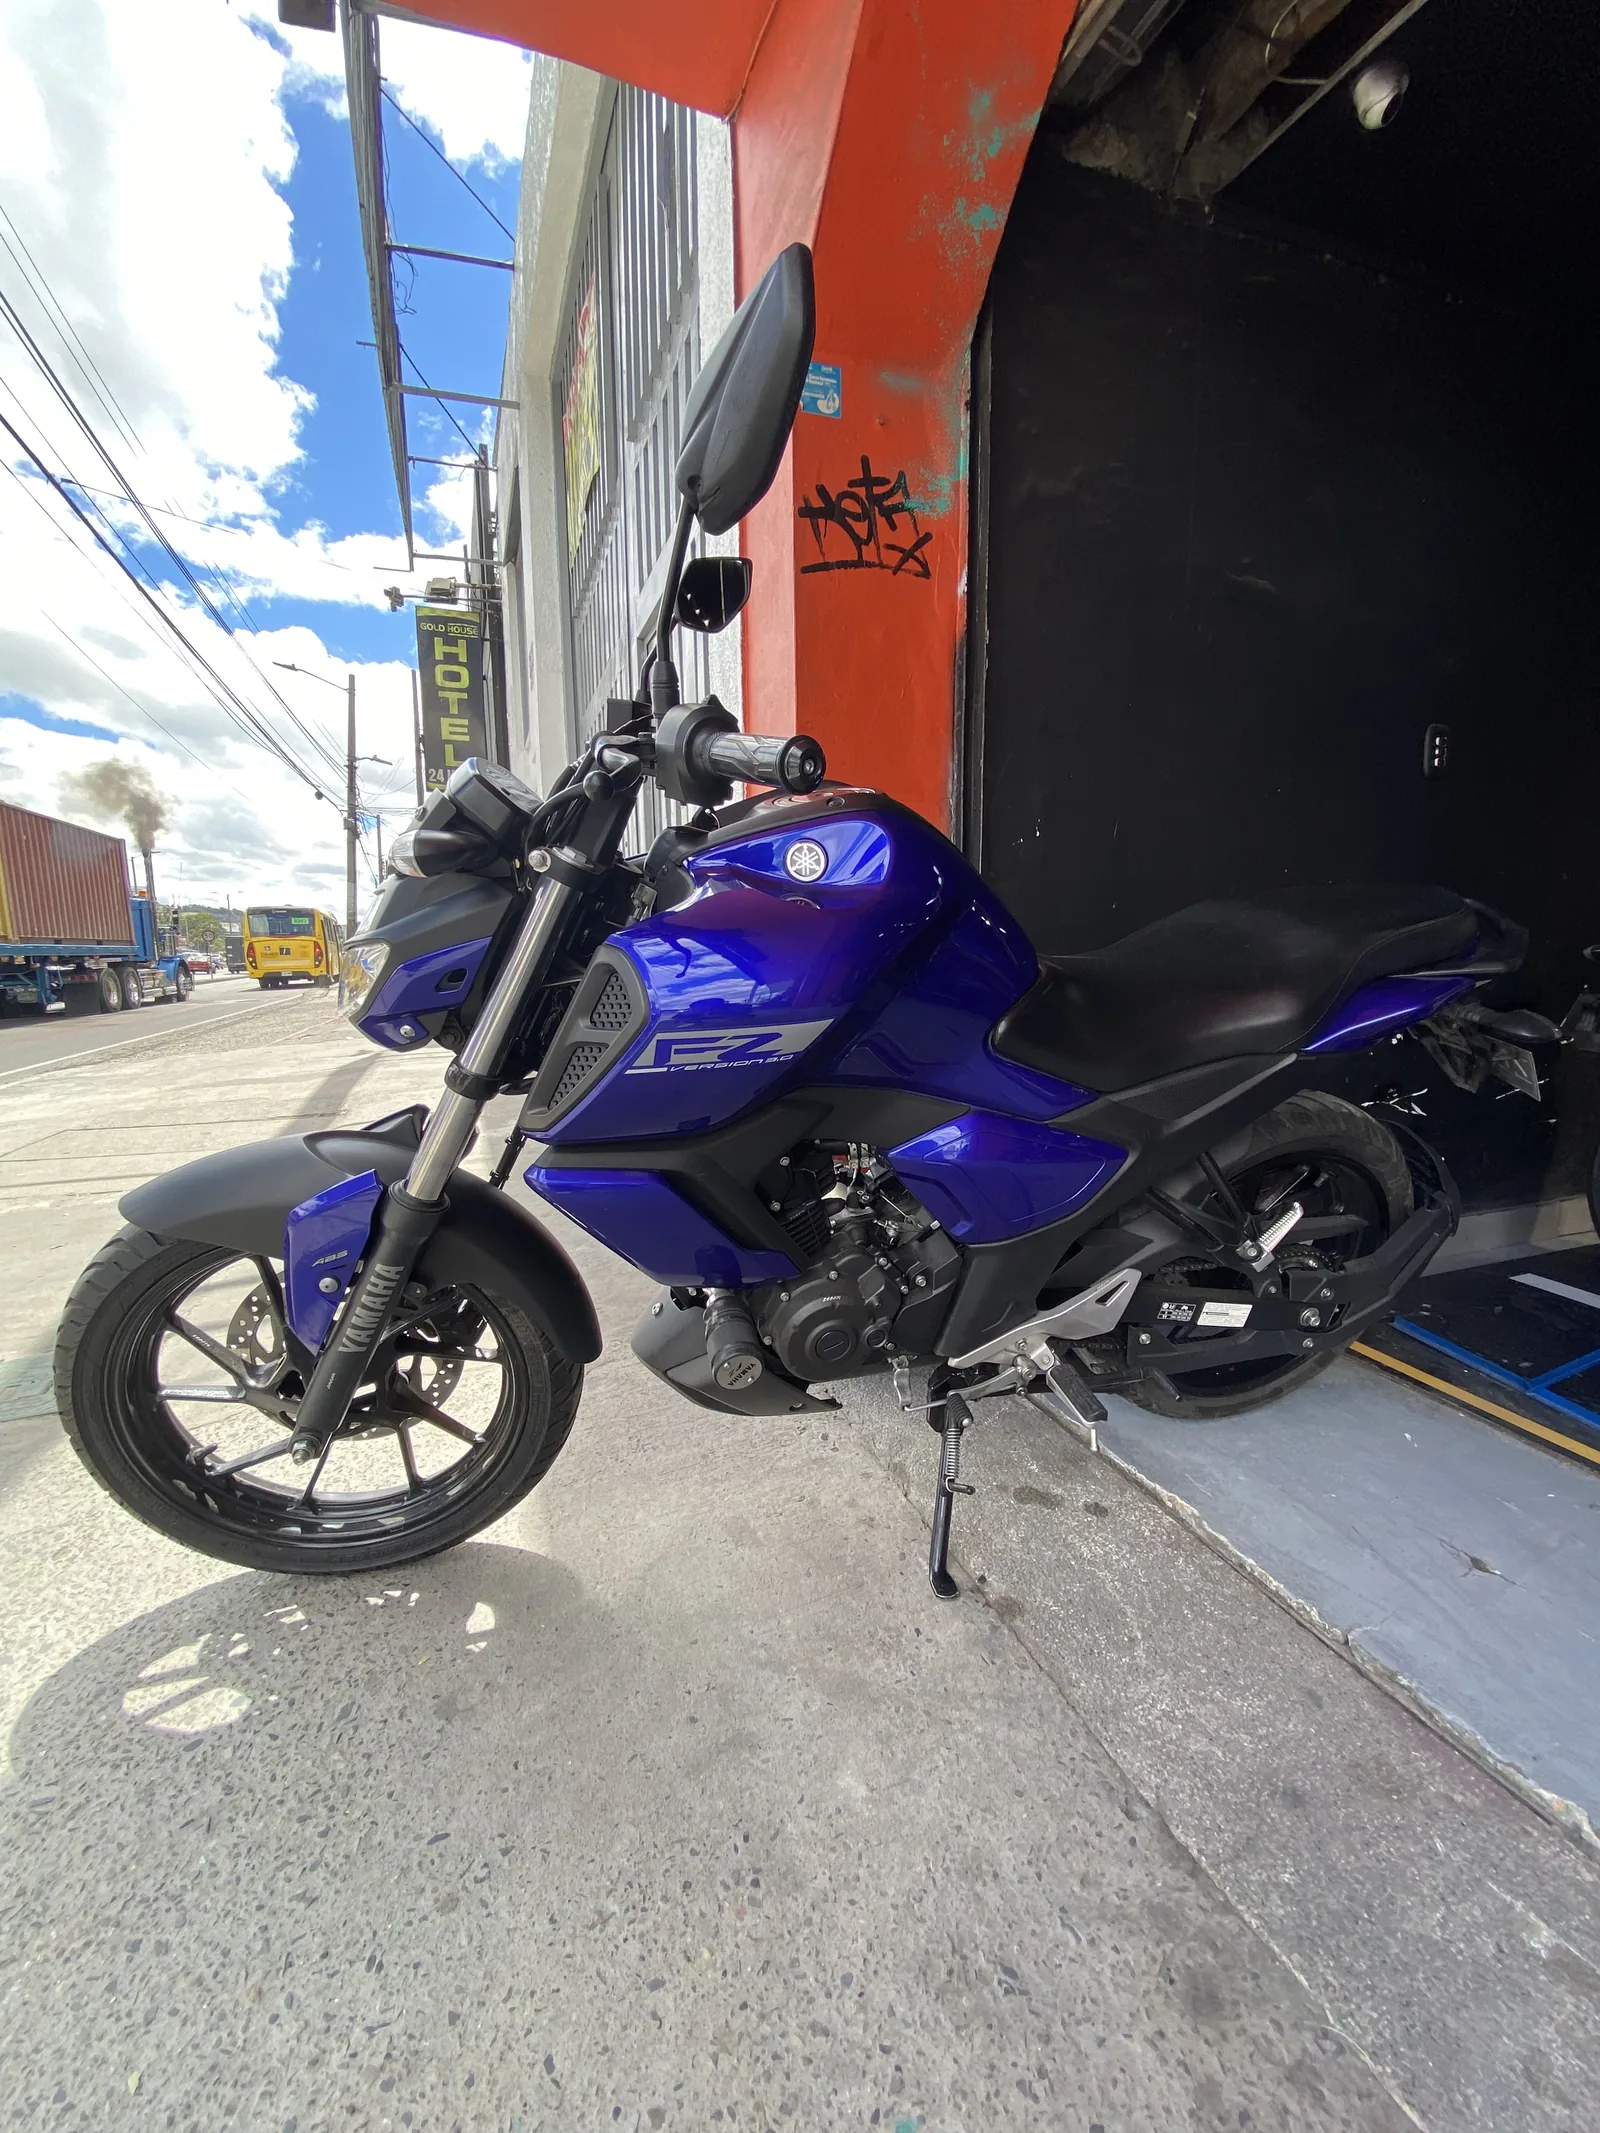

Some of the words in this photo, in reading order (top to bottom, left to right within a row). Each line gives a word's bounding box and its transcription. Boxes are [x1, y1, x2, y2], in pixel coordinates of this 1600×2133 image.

[420, 622, 446, 632] GOLD
[447, 625, 479, 635] HOUSE
[434, 637, 470, 767] HOTEL
[428, 768, 445, 782] 24
[670, 1057, 764, 1072] VERSION
[311, 1249, 348, 1267] ABS
[338, 1263, 405, 1353] YAMAHA
[728, 1362, 757, 1387] YAMAHA
